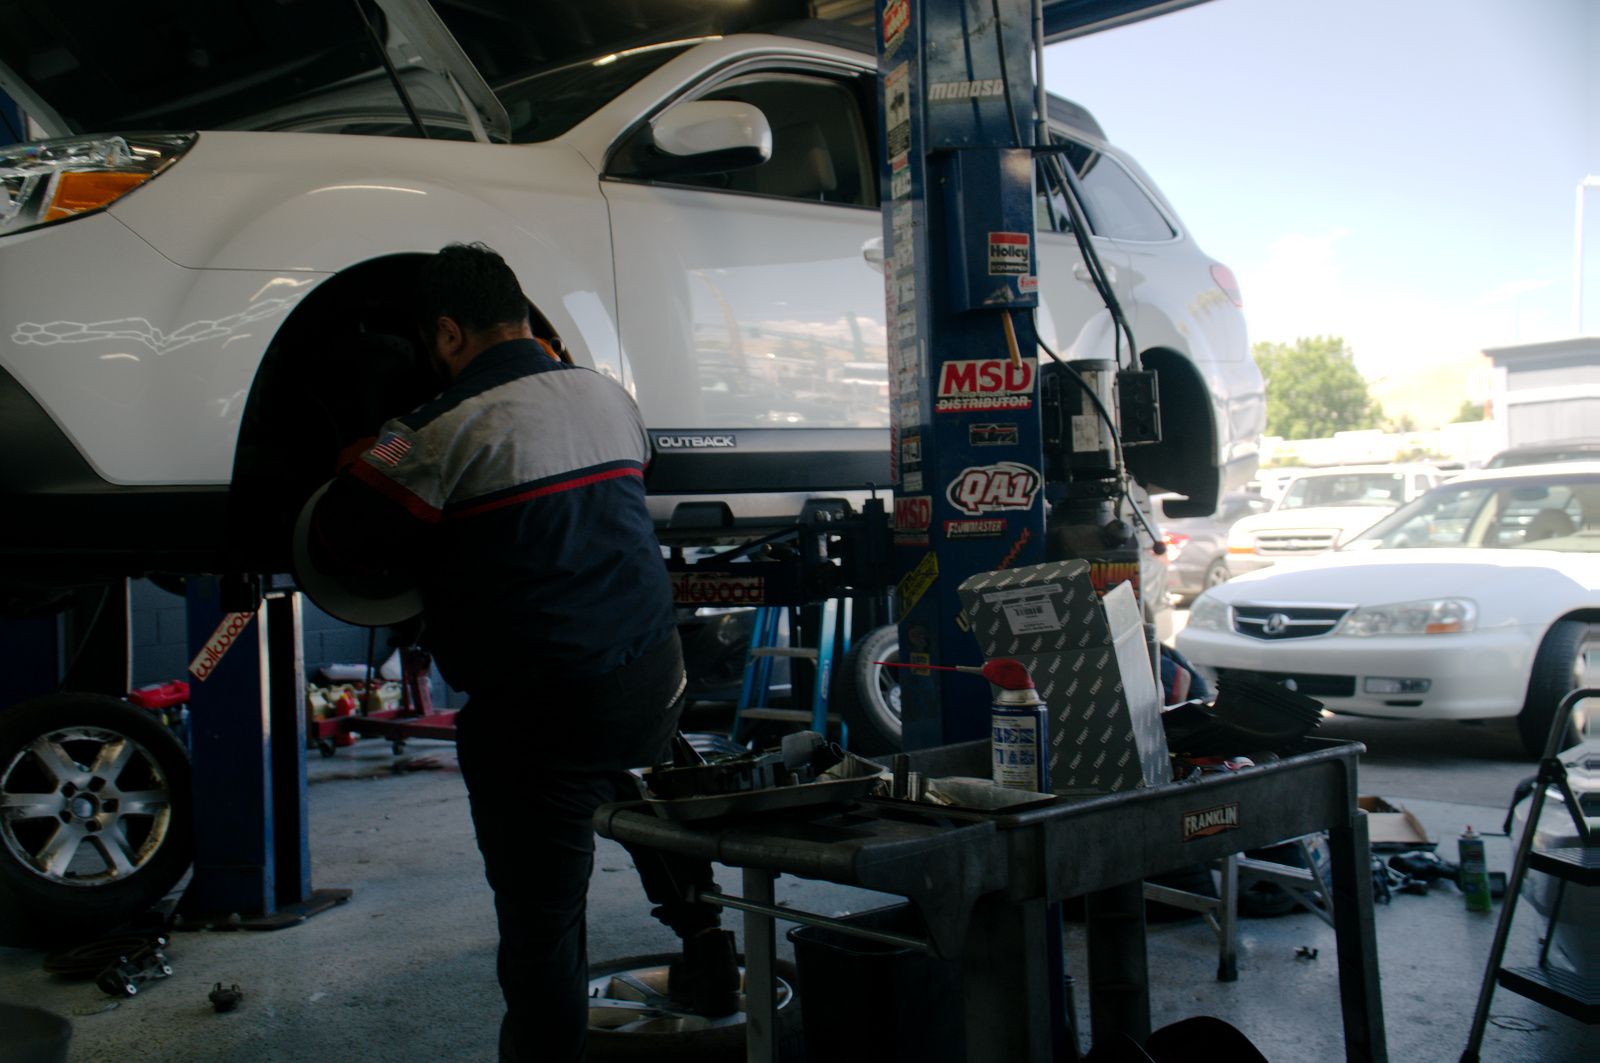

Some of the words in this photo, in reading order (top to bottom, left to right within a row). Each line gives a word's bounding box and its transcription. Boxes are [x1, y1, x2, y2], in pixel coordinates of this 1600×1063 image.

[990, 244, 1029, 262] Holley
[943, 360, 1032, 395] MSD
[937, 395, 1029, 411] DISTRIBUTOR
[658, 435, 735, 448] OUTBACK
[959, 468, 1032, 512] QA1
[895, 497, 931, 530] MSD
[1184, 806, 1237, 837] FRANKLIN
